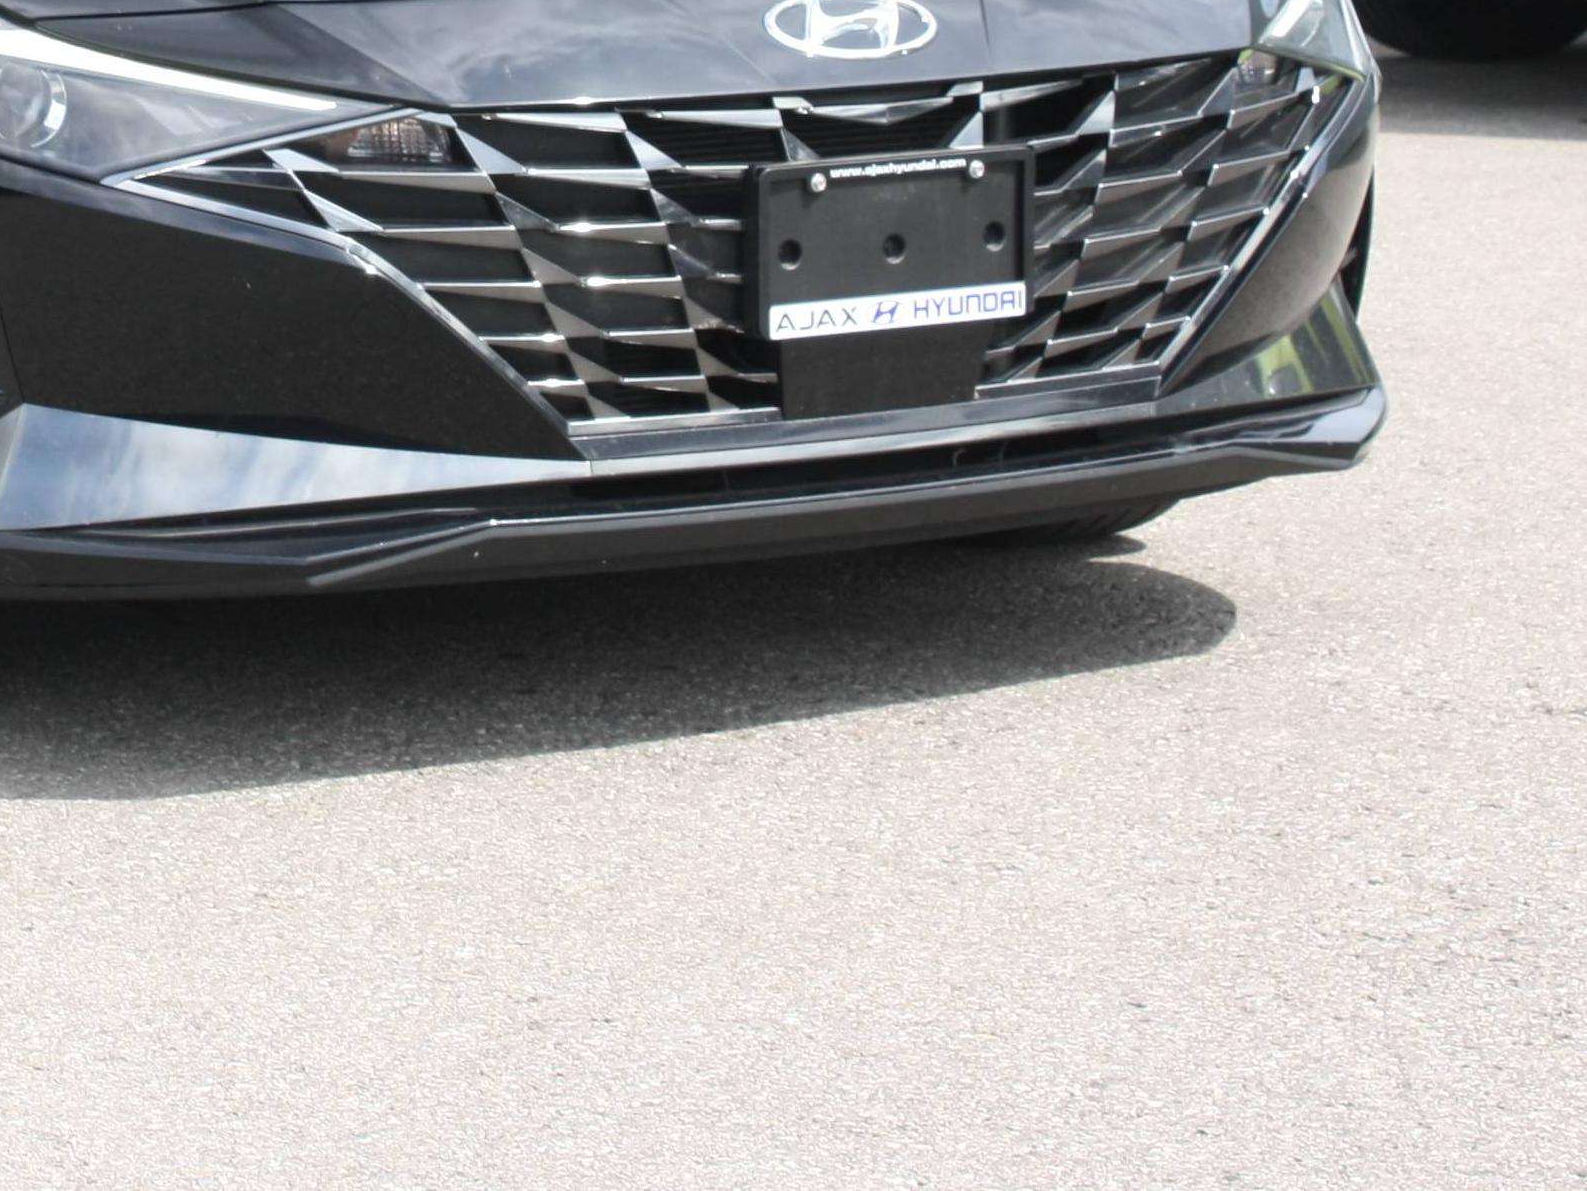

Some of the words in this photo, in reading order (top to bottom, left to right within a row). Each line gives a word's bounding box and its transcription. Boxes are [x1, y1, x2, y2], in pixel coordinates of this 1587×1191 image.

[829, 158, 967, 178] www.ajaxhyundai.com
[776, 306, 858, 332] AJAX
[914, 290, 1024, 318] HYUNDAI
